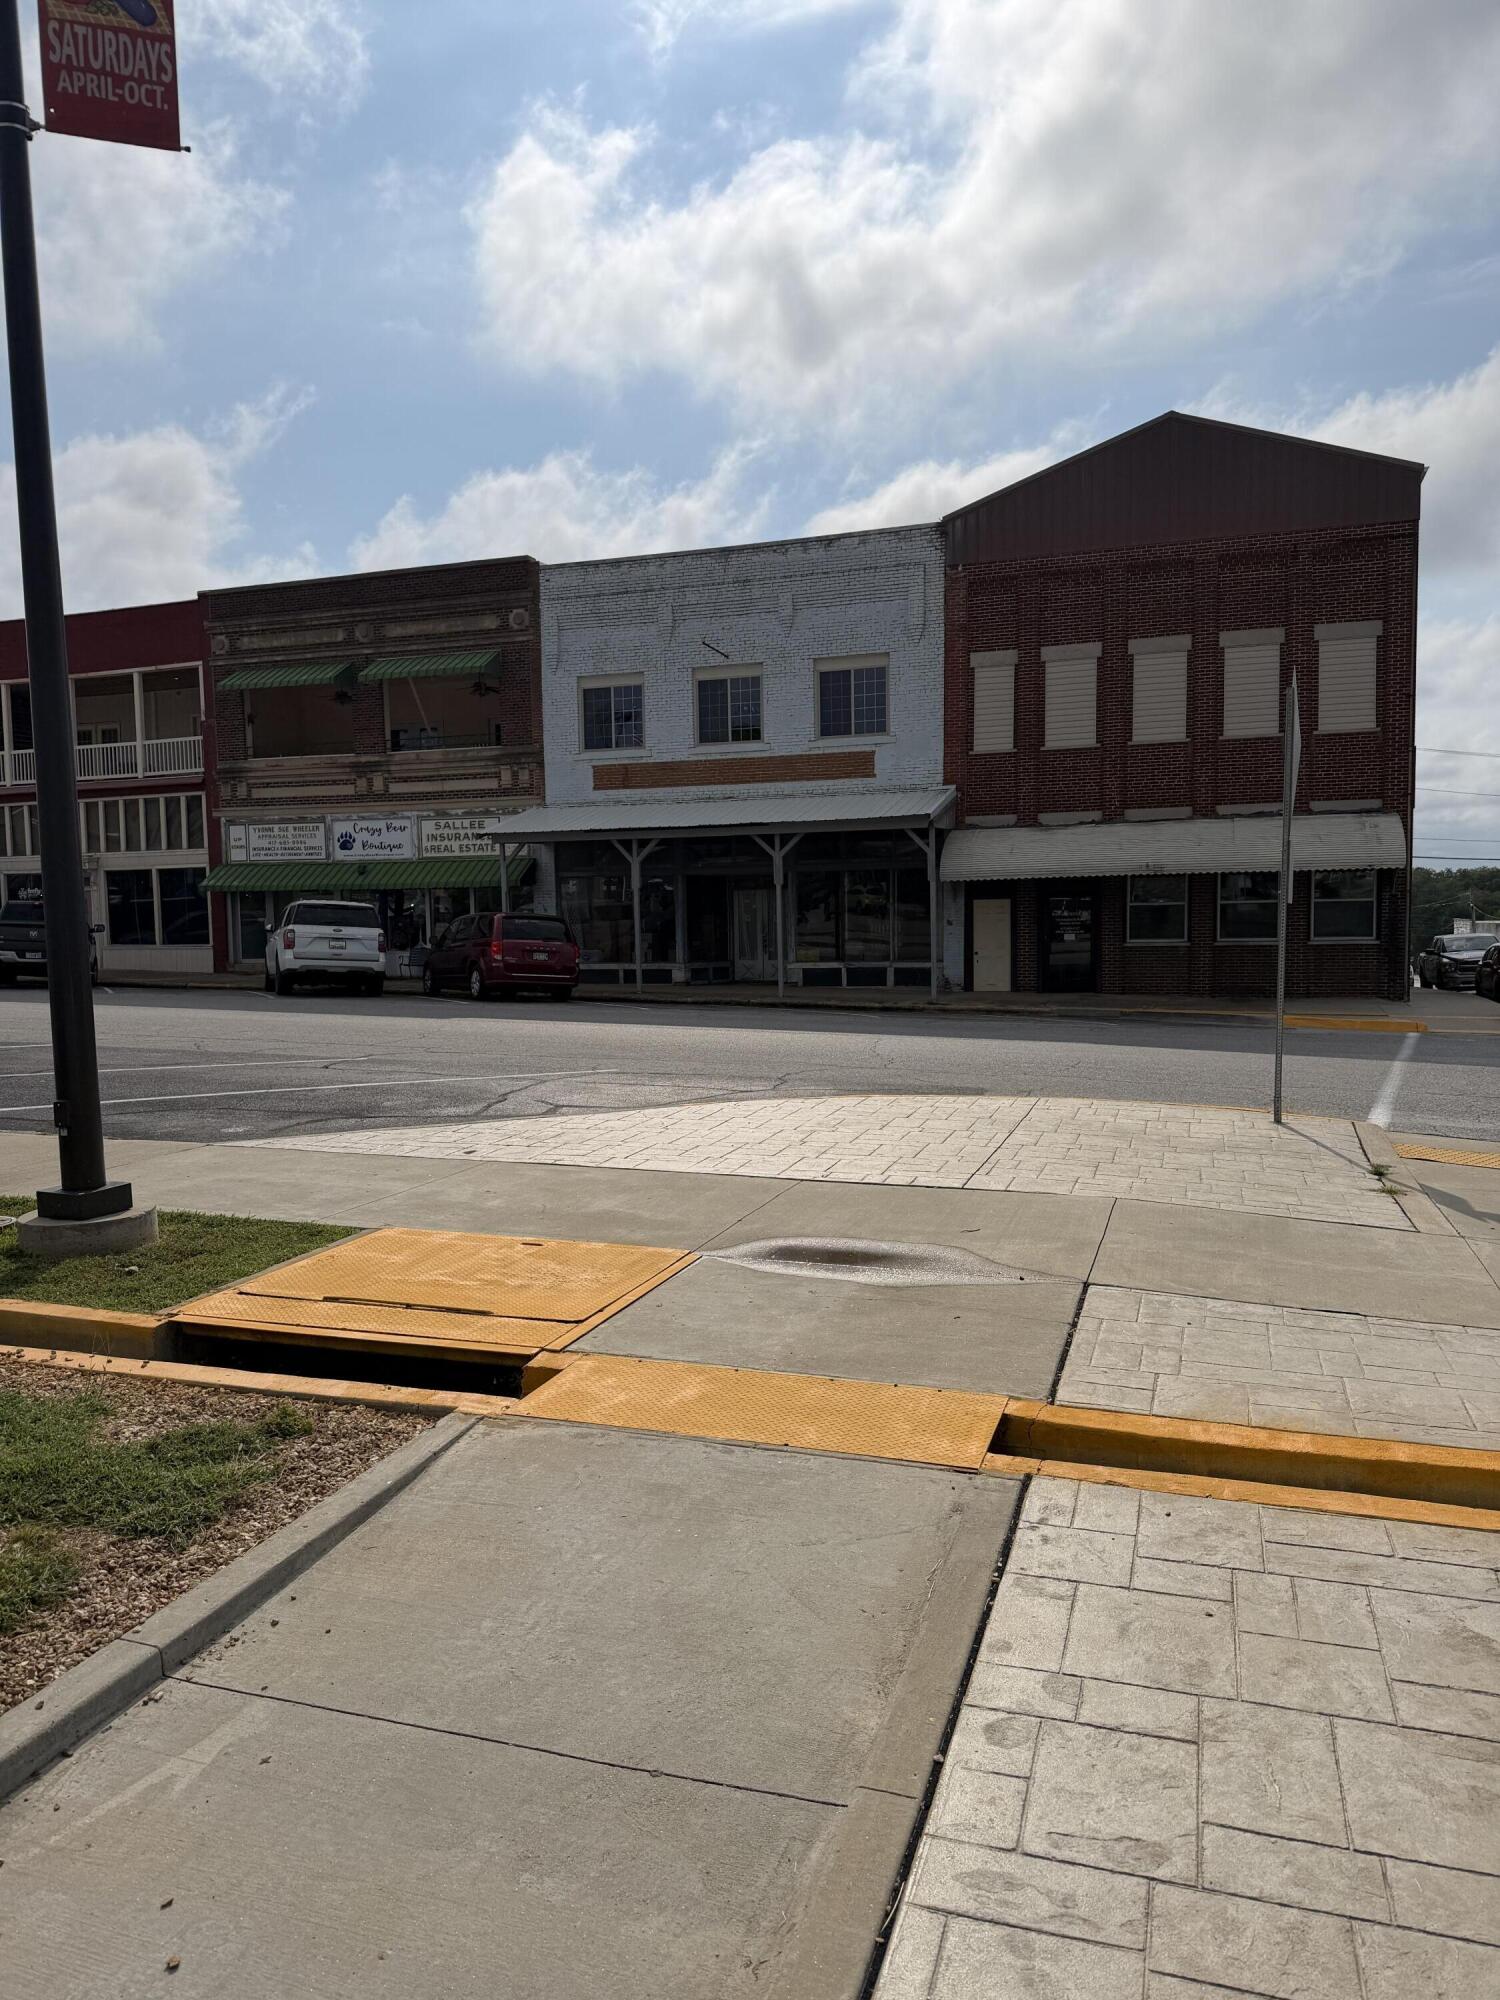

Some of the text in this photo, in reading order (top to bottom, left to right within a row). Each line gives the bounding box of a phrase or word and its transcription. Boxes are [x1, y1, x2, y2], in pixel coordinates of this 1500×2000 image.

[48, 19, 173, 83] SATURDAYS
[56, 69, 169, 110] APRIL-OCT.
[353, 822, 408, 837] Crazy Bear
[434, 820, 486, 830] SALLEE
[427, 832, 494, 841] INSURAN
[361, 840, 404, 852] Boutique
[459, 843, 497, 852] ESTATE
